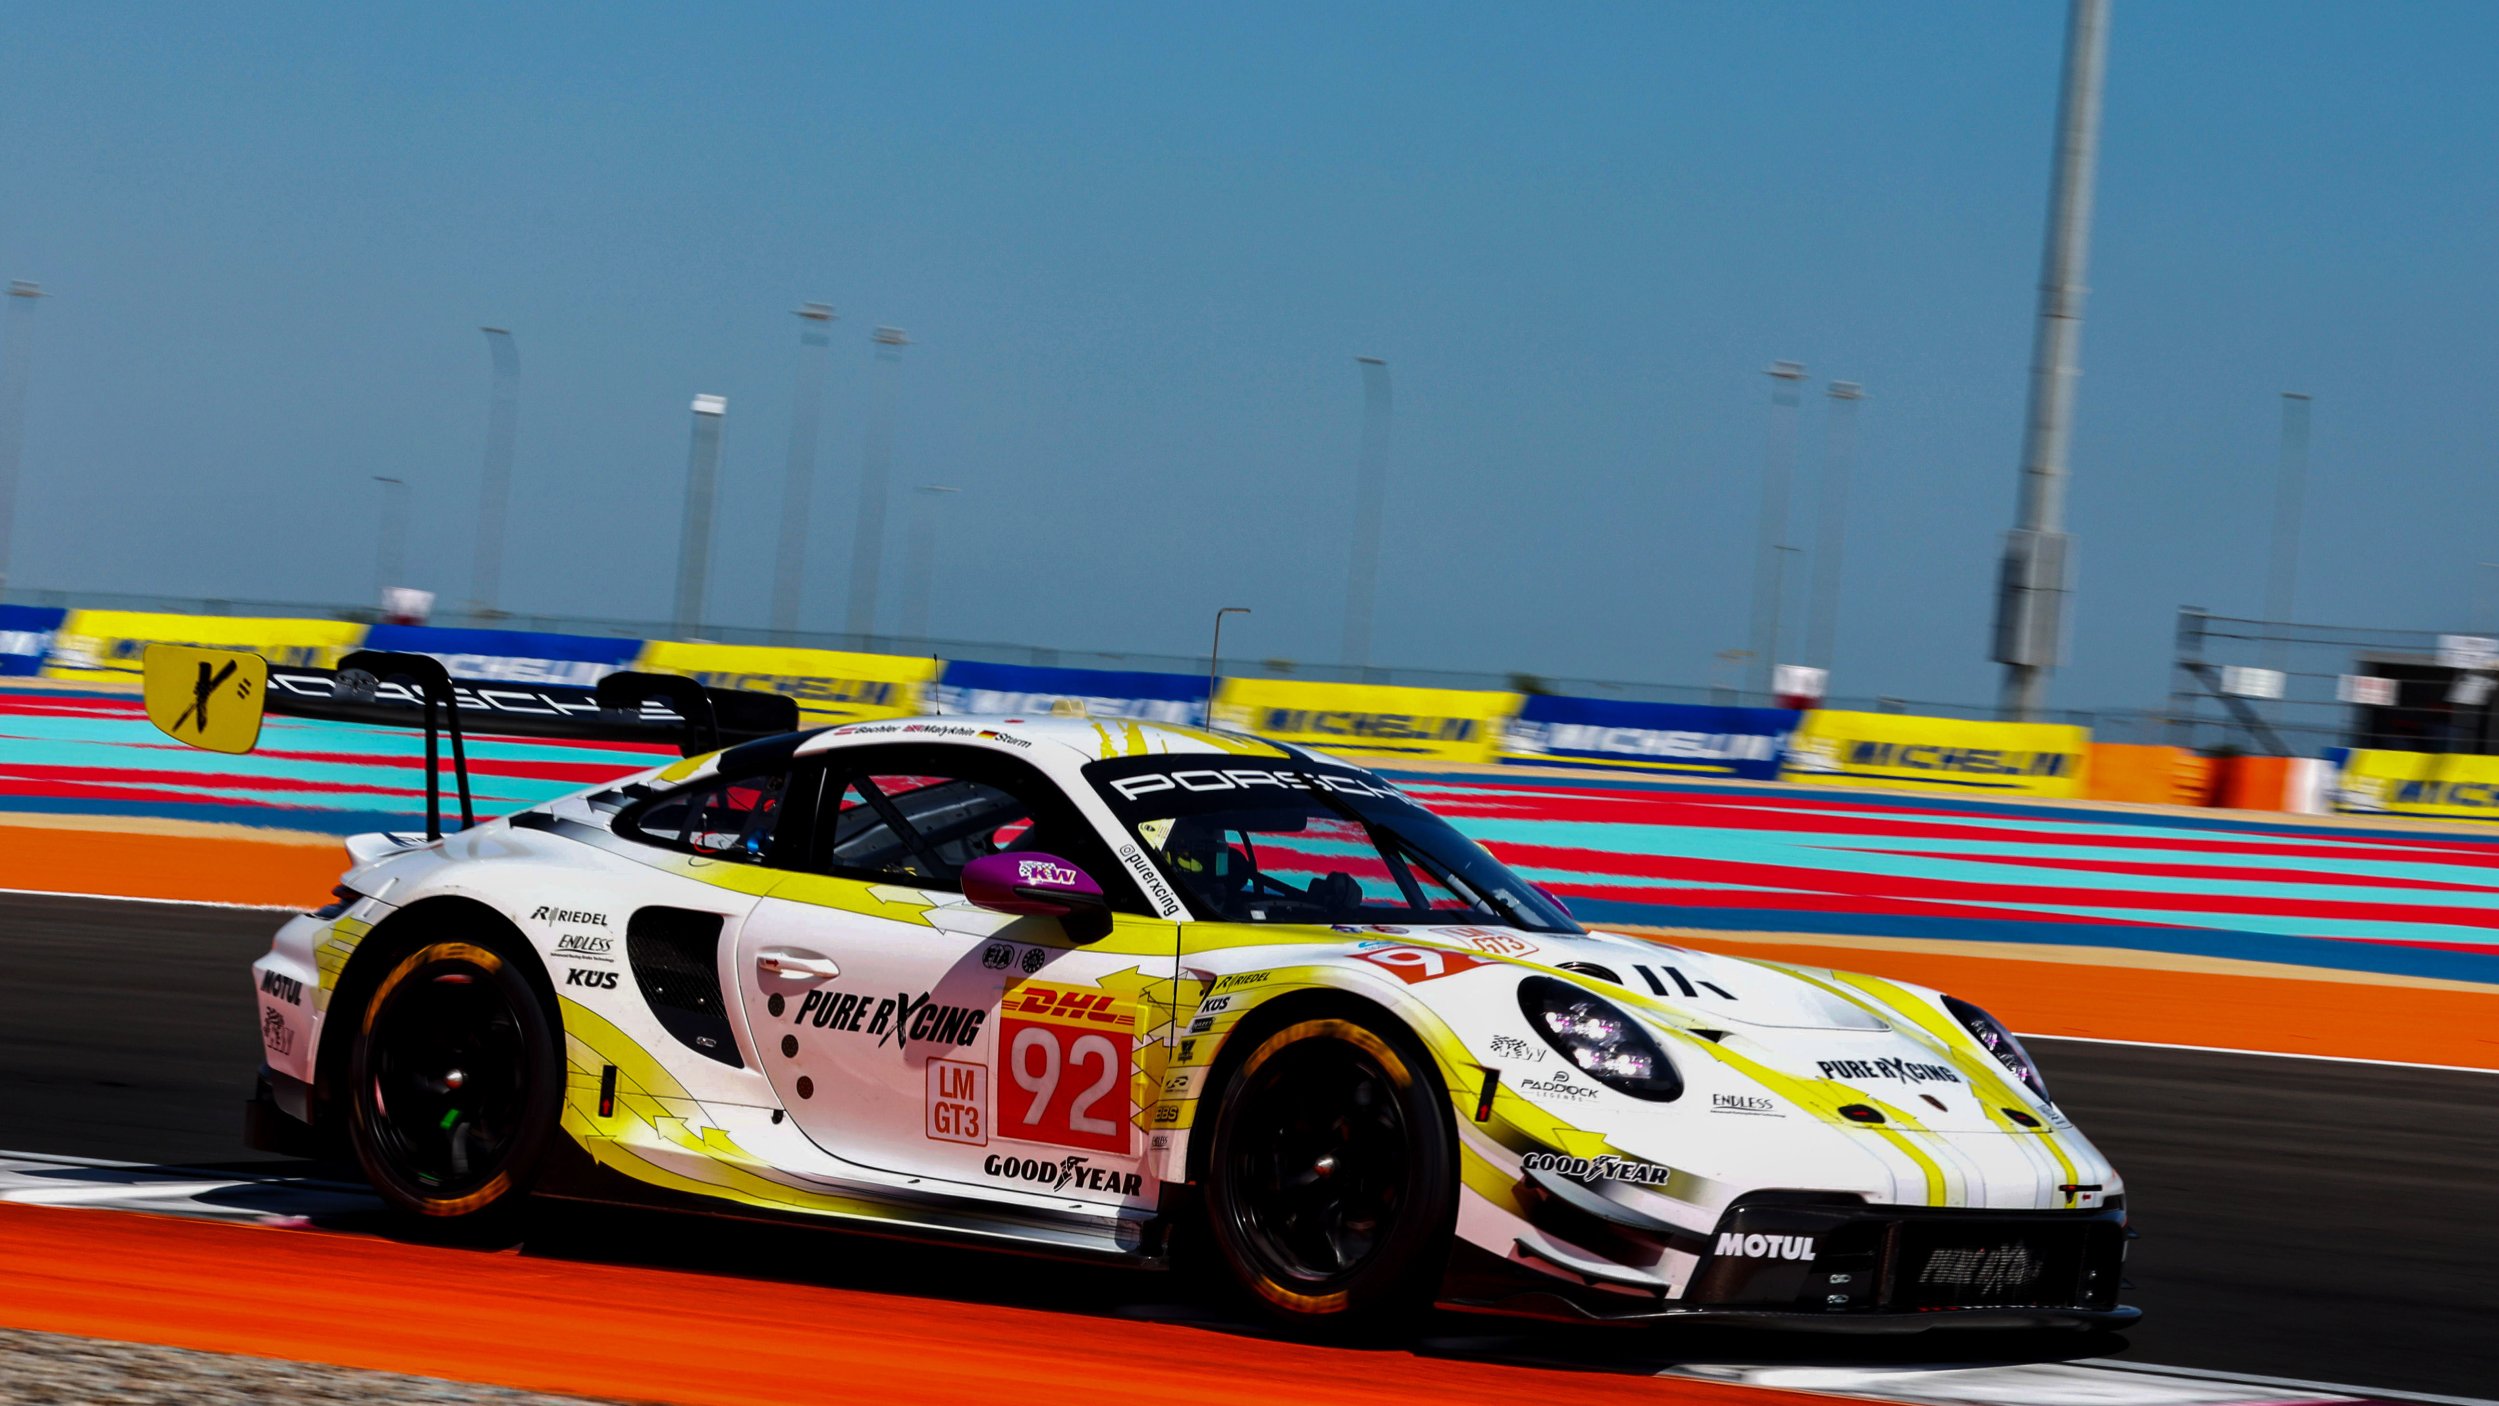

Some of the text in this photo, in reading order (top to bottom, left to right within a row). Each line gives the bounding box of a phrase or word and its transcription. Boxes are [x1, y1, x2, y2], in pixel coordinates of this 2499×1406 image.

[1262, 707, 1482, 742] MICHELIN
[995, 732, 1032, 748] Sturm
[1548, 722, 1775, 761] MICHELIN
[1848, 740, 2077, 778] MICHELIN
[2394, 779, 2499, 808] MIC
[1030, 866, 1076, 885] KW
[558, 910, 608, 926] RIEDEL
[558, 934, 614, 952] ENDLESS
[260, 969, 303, 1006] MOTUL
[566, 968, 619, 989] KÜS
[1234, 972, 1270, 986] RIEDEL
[795, 989, 875, 1032] PURE
[1017, 988, 1115, 1023] DHL
[1202, 997, 1231, 1013] KÜS
[1011, 1027, 1118, 1136] 92
[1817, 1060, 1879, 1080] PURE
[939, 1065, 975, 1101] LM
[1521, 1079, 1599, 1099] PADDOCK
[1154, 1106, 1179, 1122] BBS
[1713, 1094, 1775, 1111] ENDLESS
[934, 1101, 979, 1139] GT3
[1714, 1232, 1816, 1262] MOTUL
